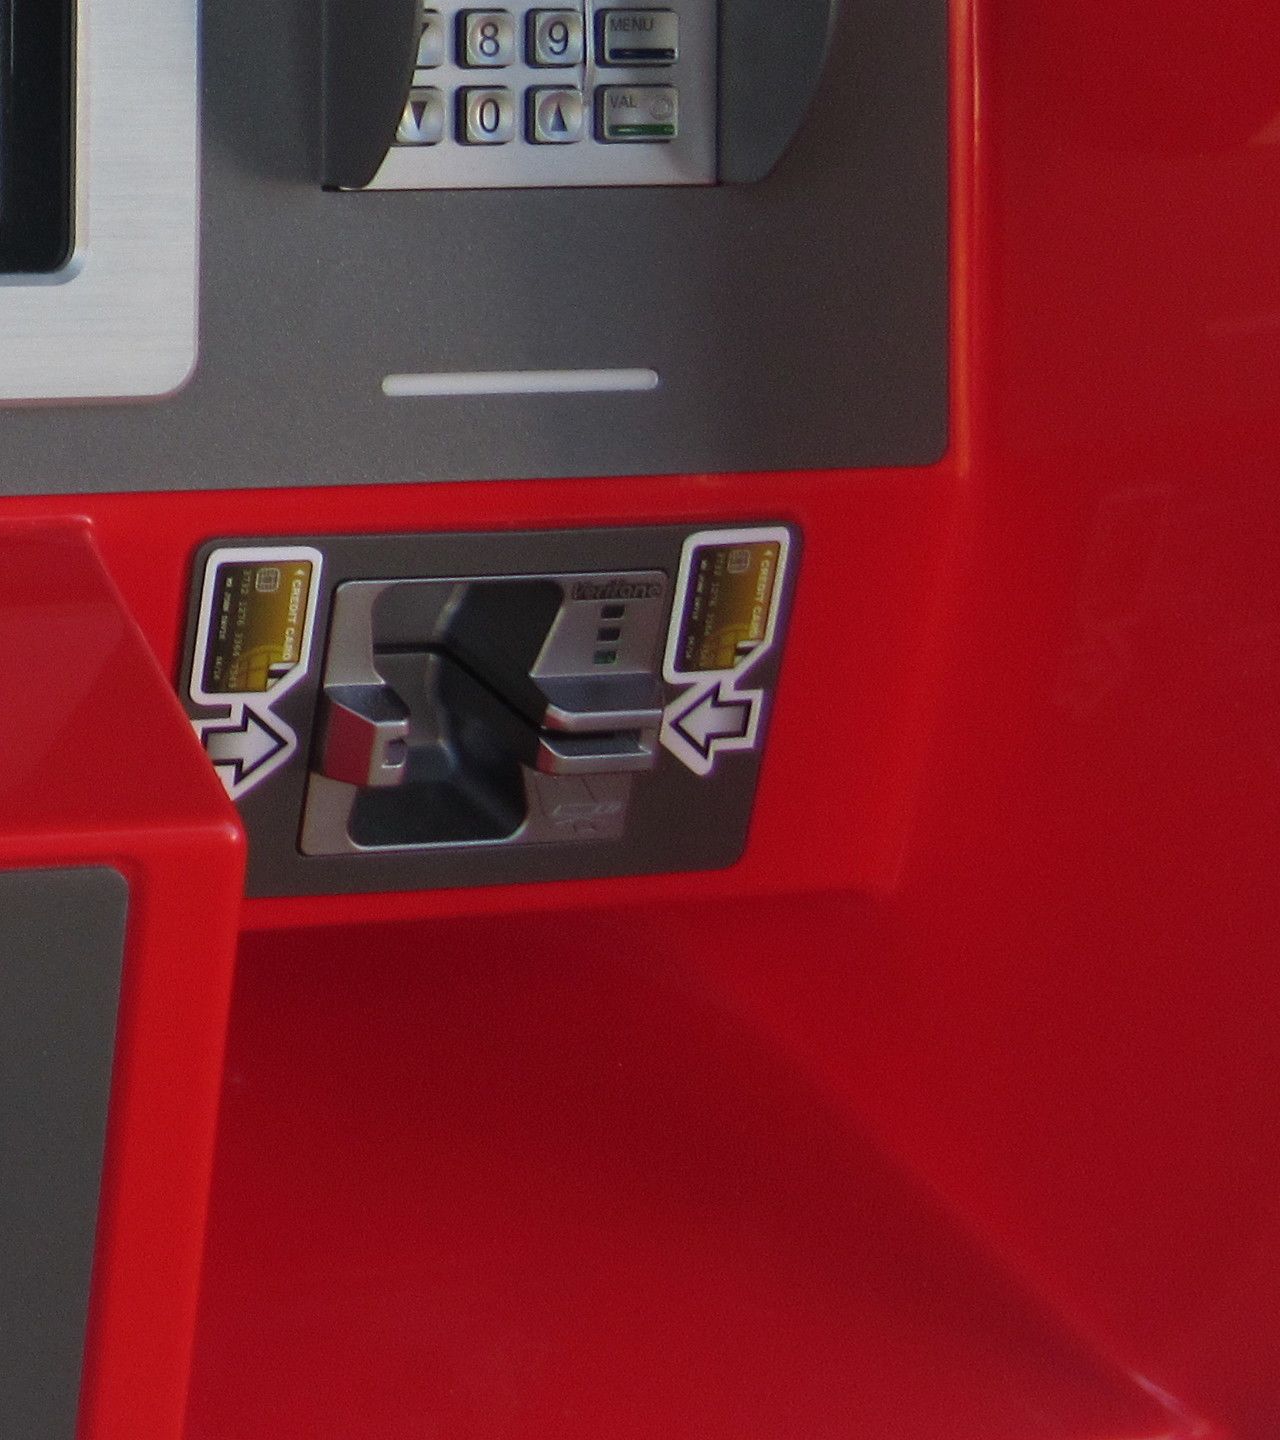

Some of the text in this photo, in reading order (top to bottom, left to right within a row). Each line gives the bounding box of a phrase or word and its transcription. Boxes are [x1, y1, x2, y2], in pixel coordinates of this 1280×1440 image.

[479, 22, 501, 58] 8
[548, 20, 570, 56] 9
[609, 17, 655, 32] MENU
[478, 97, 501, 134] 0
[609, 94, 638, 109] VAL
[286, 579, 303, 625] CREDIT
